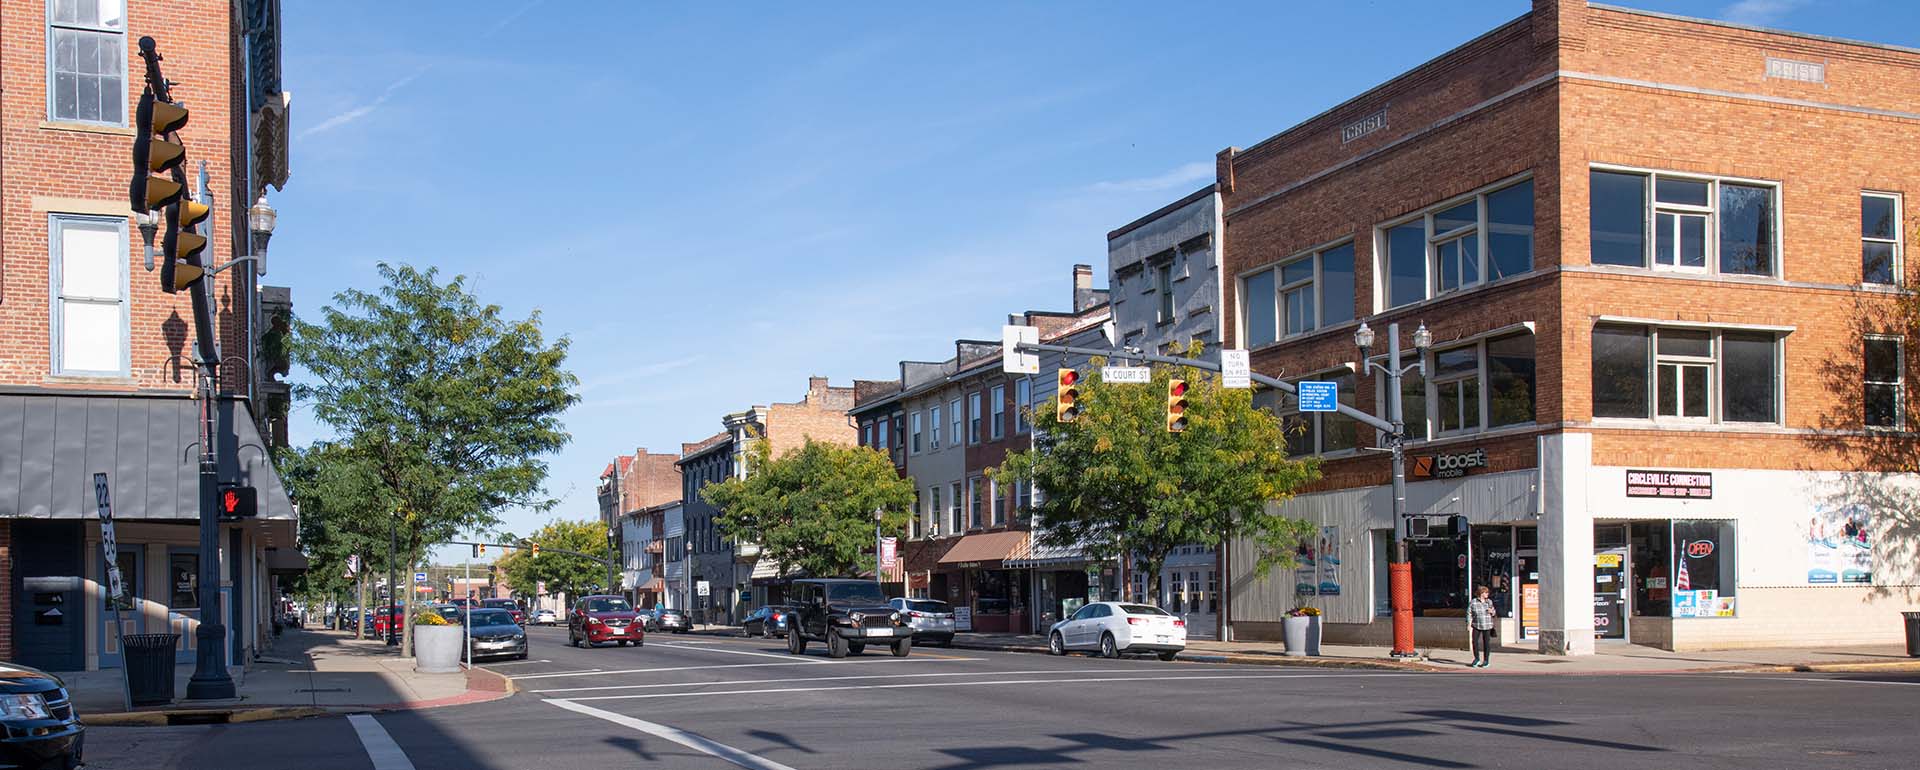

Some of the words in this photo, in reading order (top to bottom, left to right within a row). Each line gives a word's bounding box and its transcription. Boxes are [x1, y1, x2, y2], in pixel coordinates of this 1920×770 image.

[1772, 60, 1822, 81] CRIST
[1346, 113, 1383, 140] CRIST
[1104, 370, 1110, 379] N
[1113, 370, 1136, 380] COURT
[1139, 370, 1147, 380] ST
[1438, 449, 1484, 470] boost
[1438, 468, 1463, 478] mobile
[1628, 473, 1669, 485] CIRCLEVILLE
[1670, 474, 1711, 486] CONNECTION
[96, 483, 110, 508] 22
[103, 531, 116, 557] 56
[1688, 543, 1713, 555] OPEN
